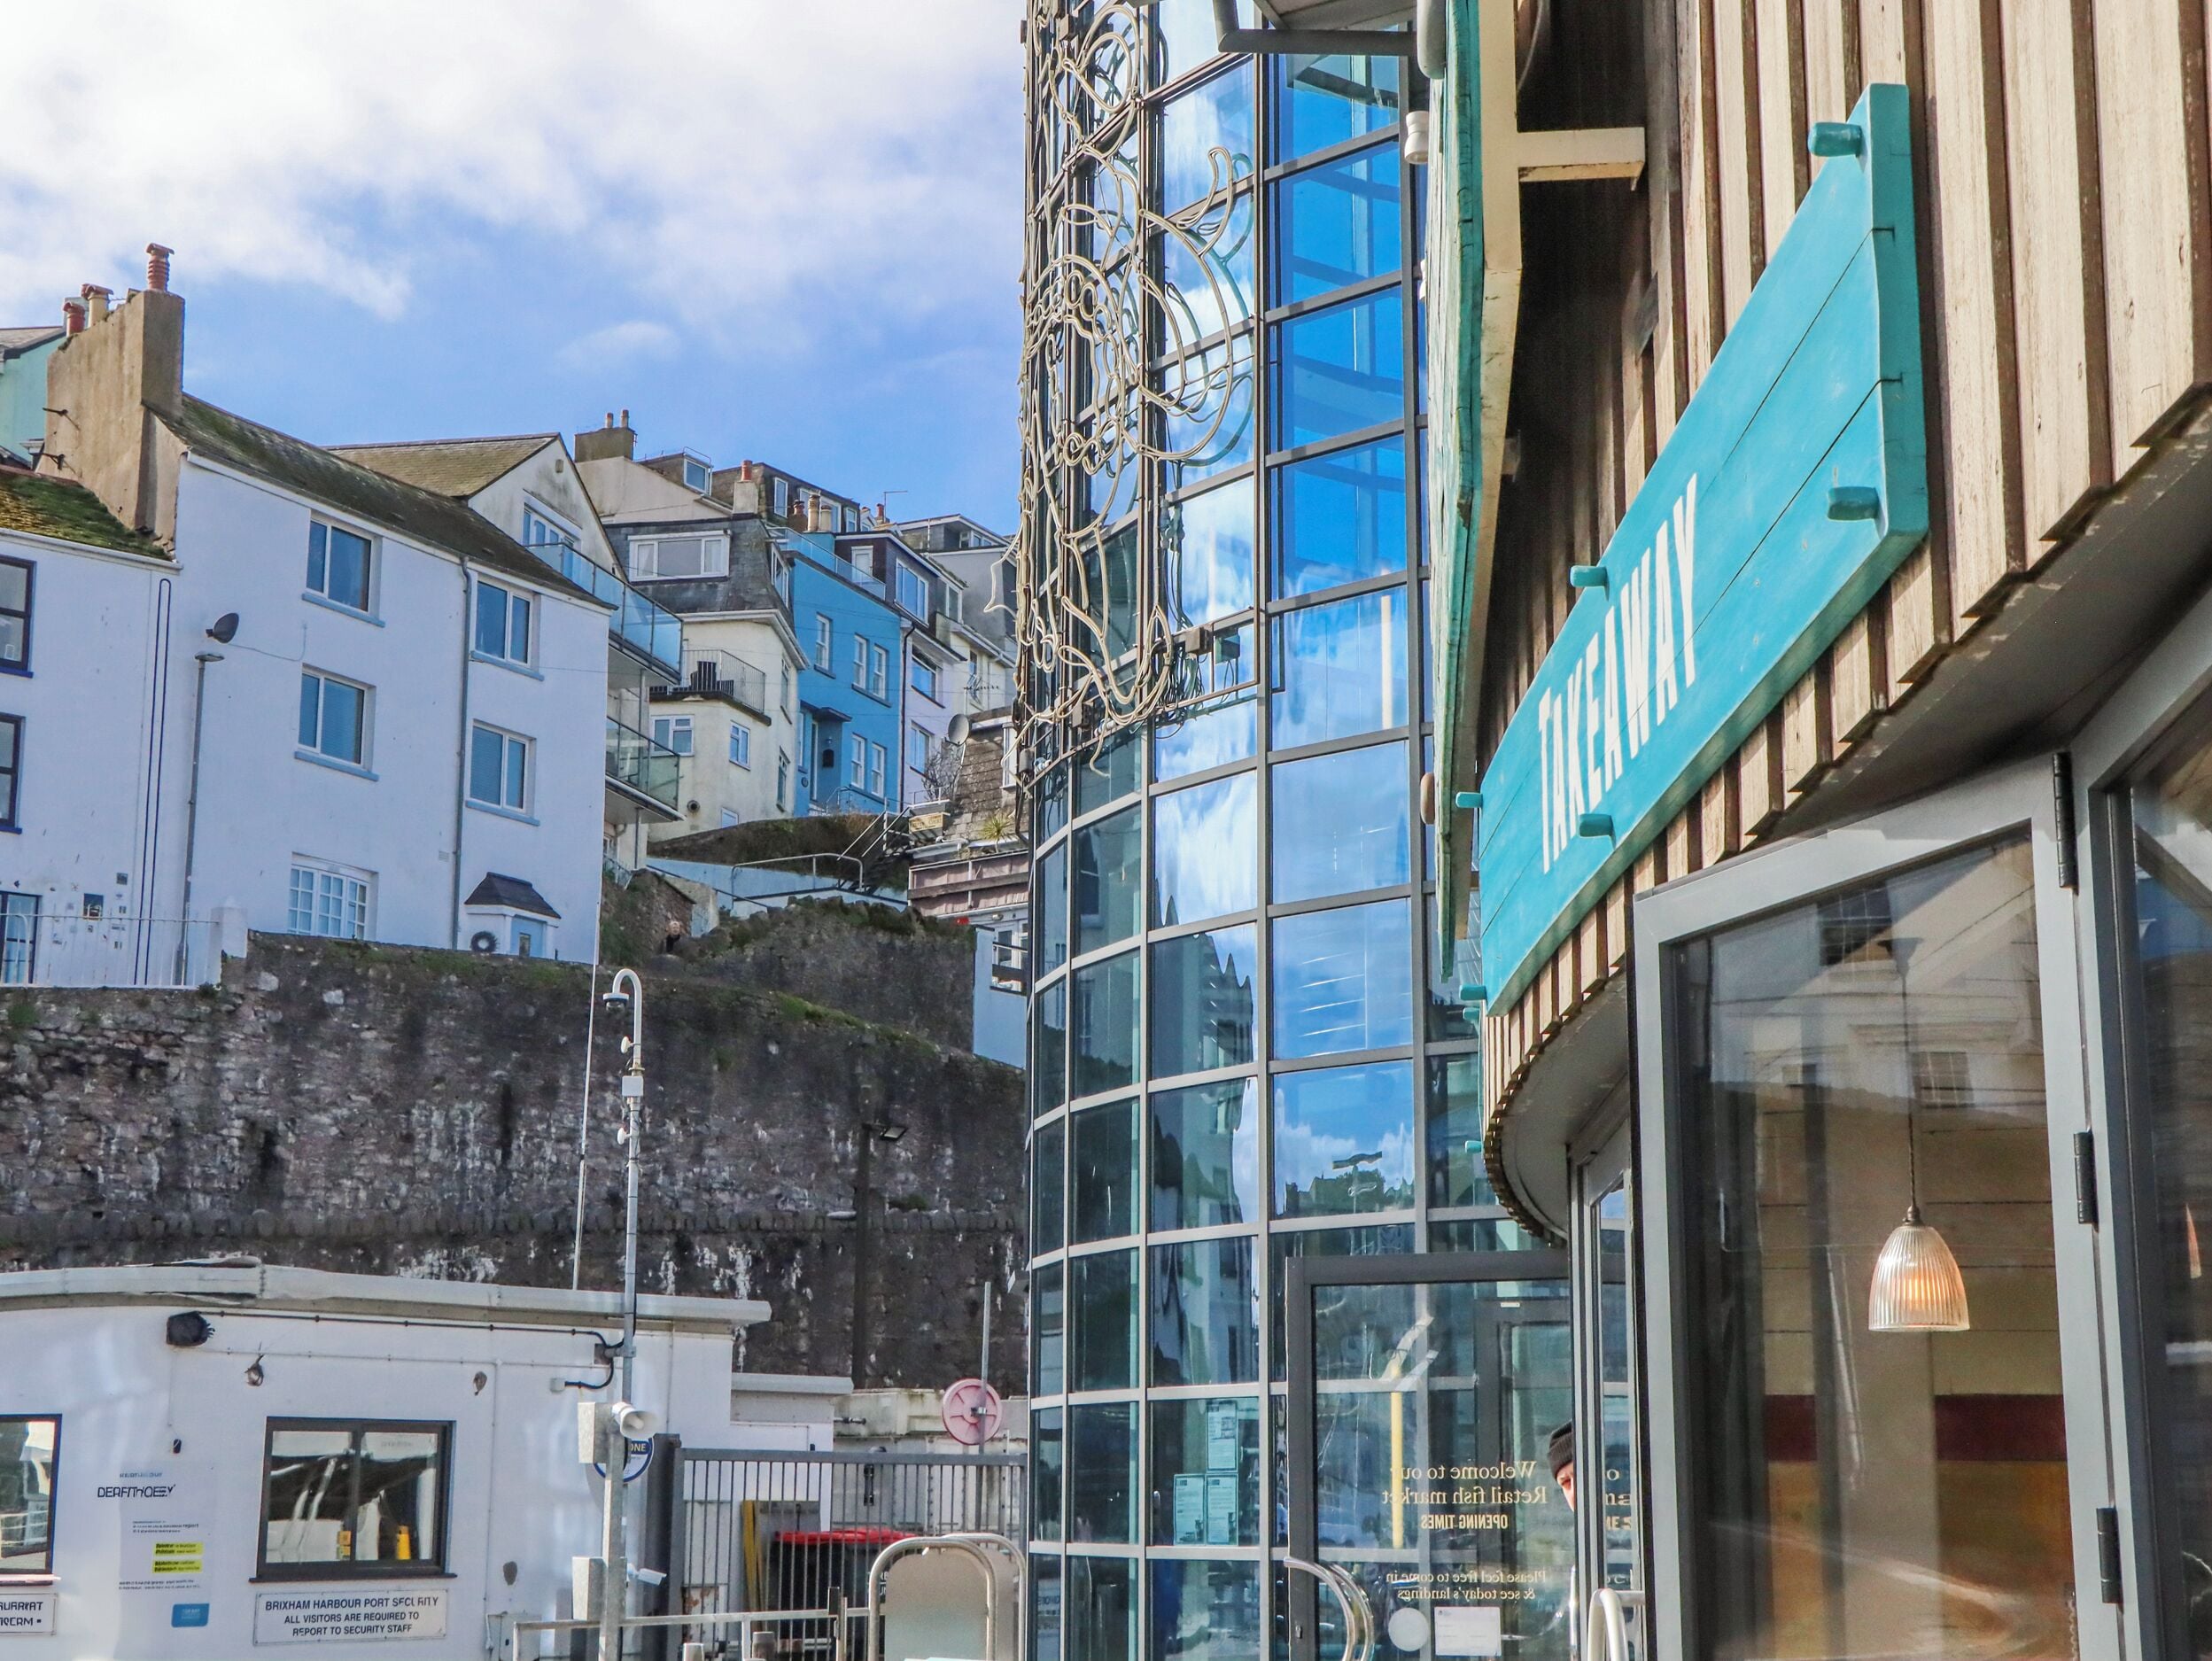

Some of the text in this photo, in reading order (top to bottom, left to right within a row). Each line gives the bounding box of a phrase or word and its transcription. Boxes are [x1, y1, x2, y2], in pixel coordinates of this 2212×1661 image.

[1539, 473, 1696, 874] TAKEAWAY
[266, 1600, 310, 1611] BRIXHAM
[313, 1598, 361, 1609] HARBOUR
[364, 1597, 390, 1608] PORT
[283, 1611, 420, 1624] ALL VISITORS ARE REQUIRED TO
[292, 1624, 413, 1637] REPORT TO SECURITY STAFF
